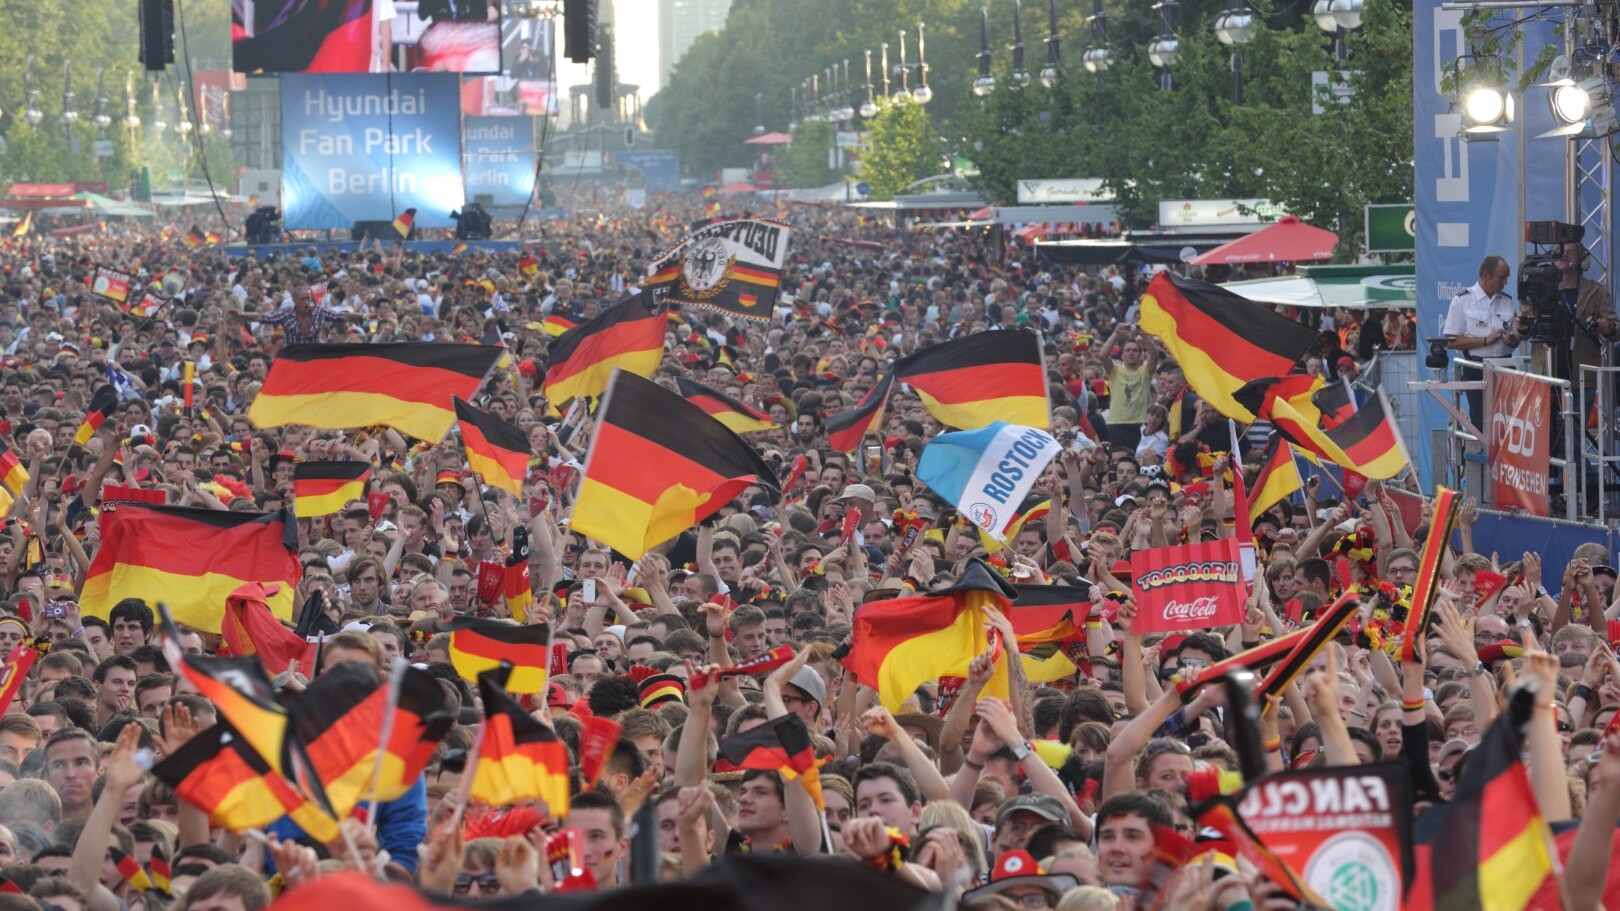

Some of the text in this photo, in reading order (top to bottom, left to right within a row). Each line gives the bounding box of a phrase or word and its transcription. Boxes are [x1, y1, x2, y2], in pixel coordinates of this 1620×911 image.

[304, 89, 426, 122] Hyundai
[300, 127, 434, 156] Fan Park
[463, 123, 515, 141] undai
[478, 146, 519, 163] Park
[327, 167, 416, 195] Berlin
[469, 169, 509, 186] erlin
[982, 428, 1053, 504] ROSTOCK
[1500, 463, 1546, 496] FERNSEHEN
[1162, 595, 1219, 620] Coca-Cola
